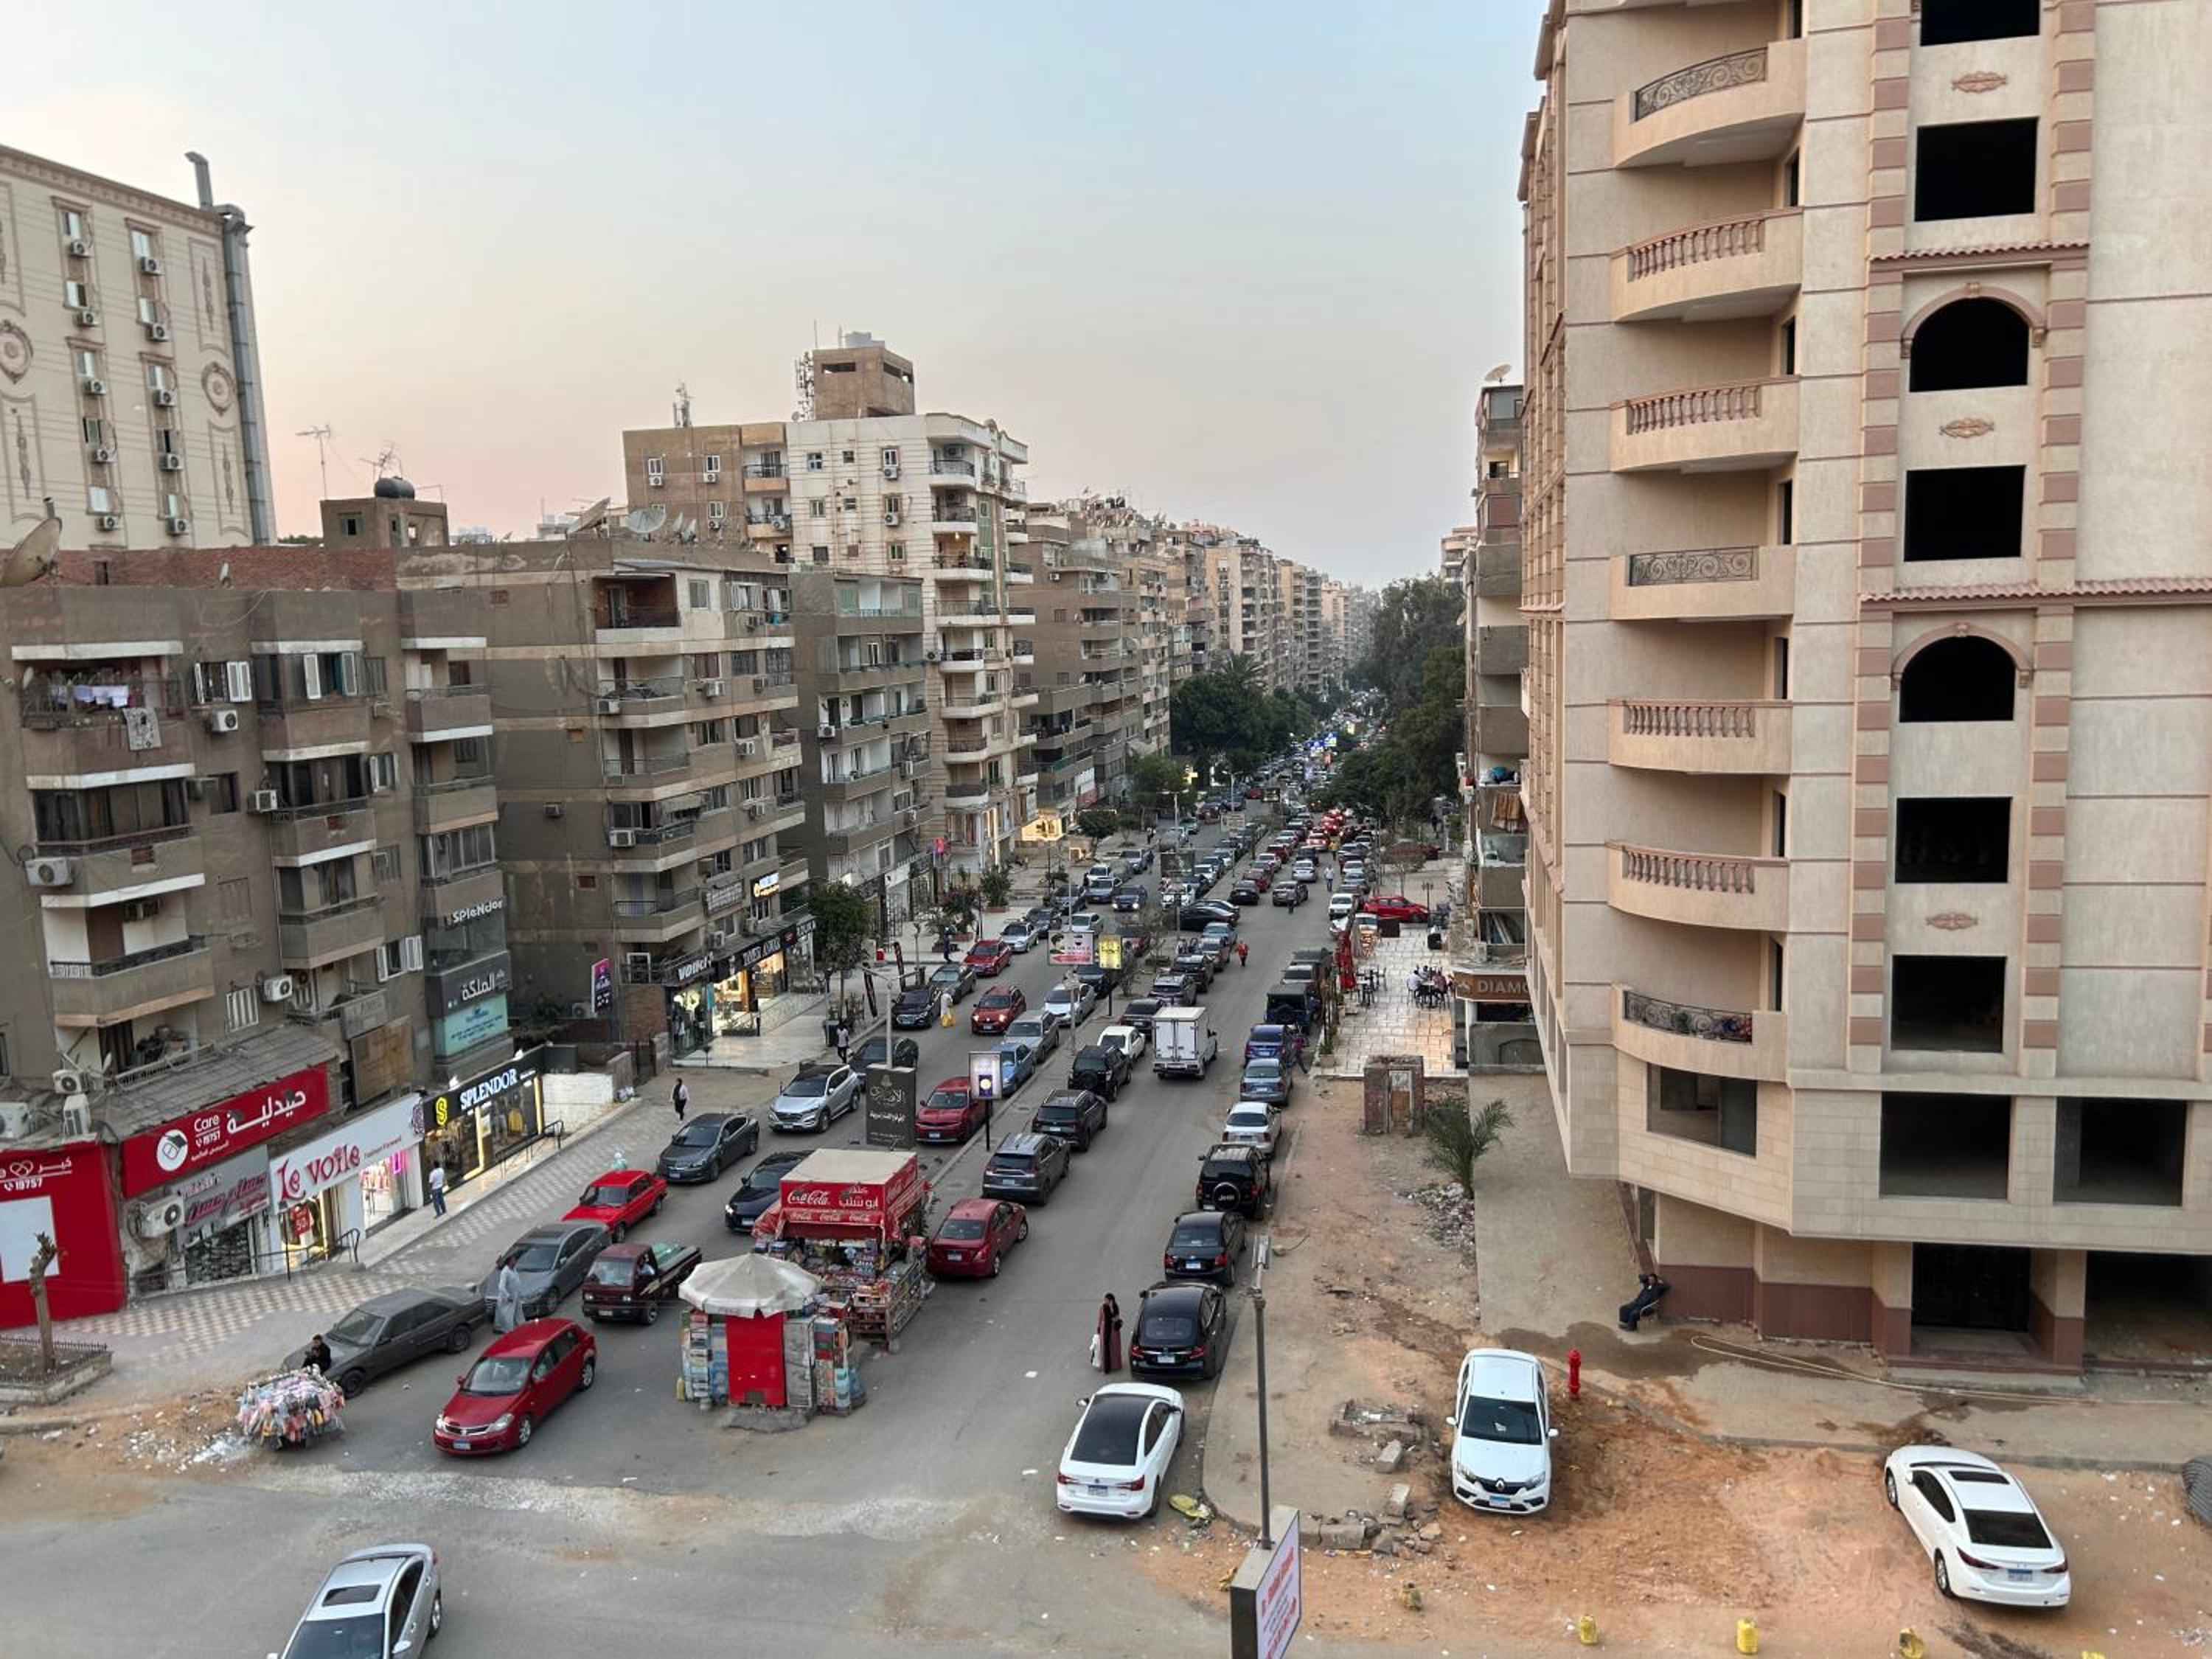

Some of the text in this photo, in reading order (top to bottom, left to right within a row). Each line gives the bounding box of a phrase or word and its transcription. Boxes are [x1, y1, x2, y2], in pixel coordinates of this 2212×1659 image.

[462, 973, 494, 1001] الملكة
[459, 1068, 517, 1110] SPLENDOR
[194, 1114, 220, 1132] Care
[276, 1158, 307, 1201] Le
